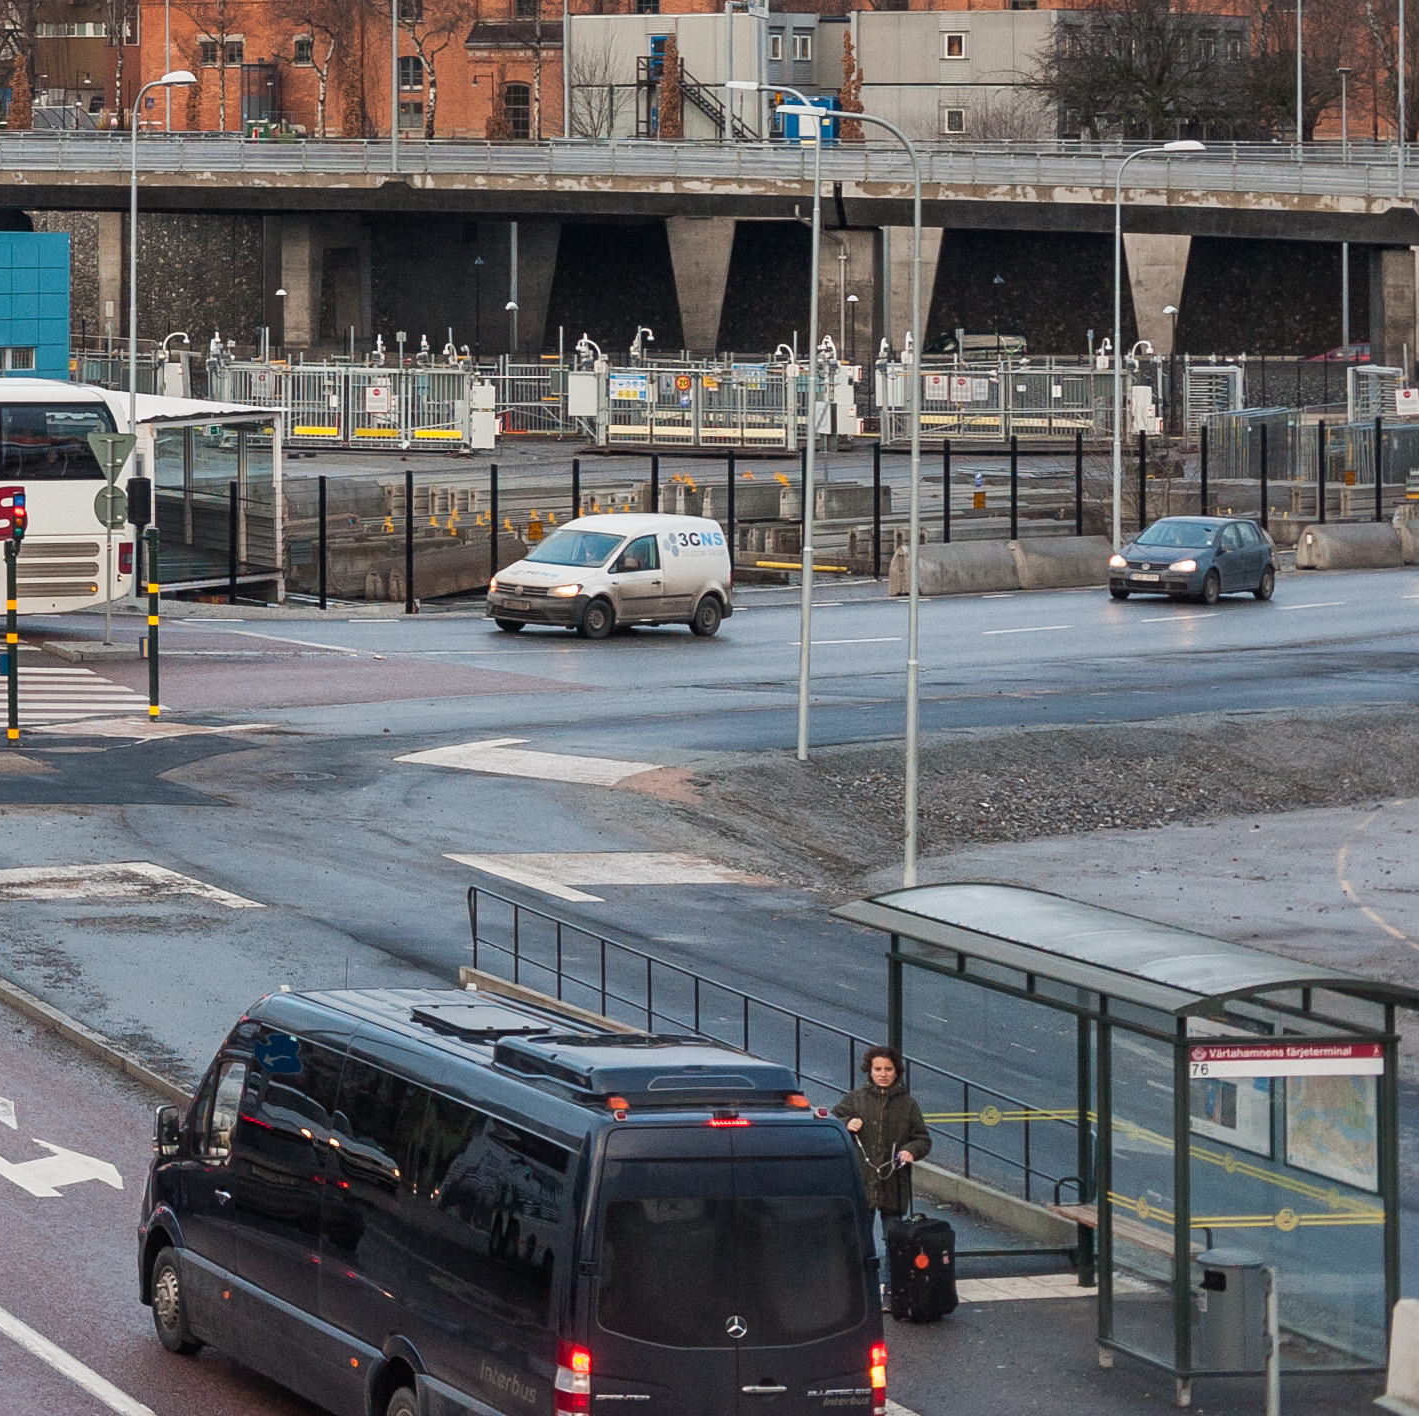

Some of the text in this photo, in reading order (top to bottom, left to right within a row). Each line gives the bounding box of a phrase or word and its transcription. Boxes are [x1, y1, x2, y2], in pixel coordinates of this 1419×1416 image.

[678, 532, 724, 547] 3GNS
[1209, 1046, 1352, 1059] Värtahamnens färjeterminal
[1192, 1063, 1209, 1075] 76
[480, 1359, 536, 1404] Interbus
